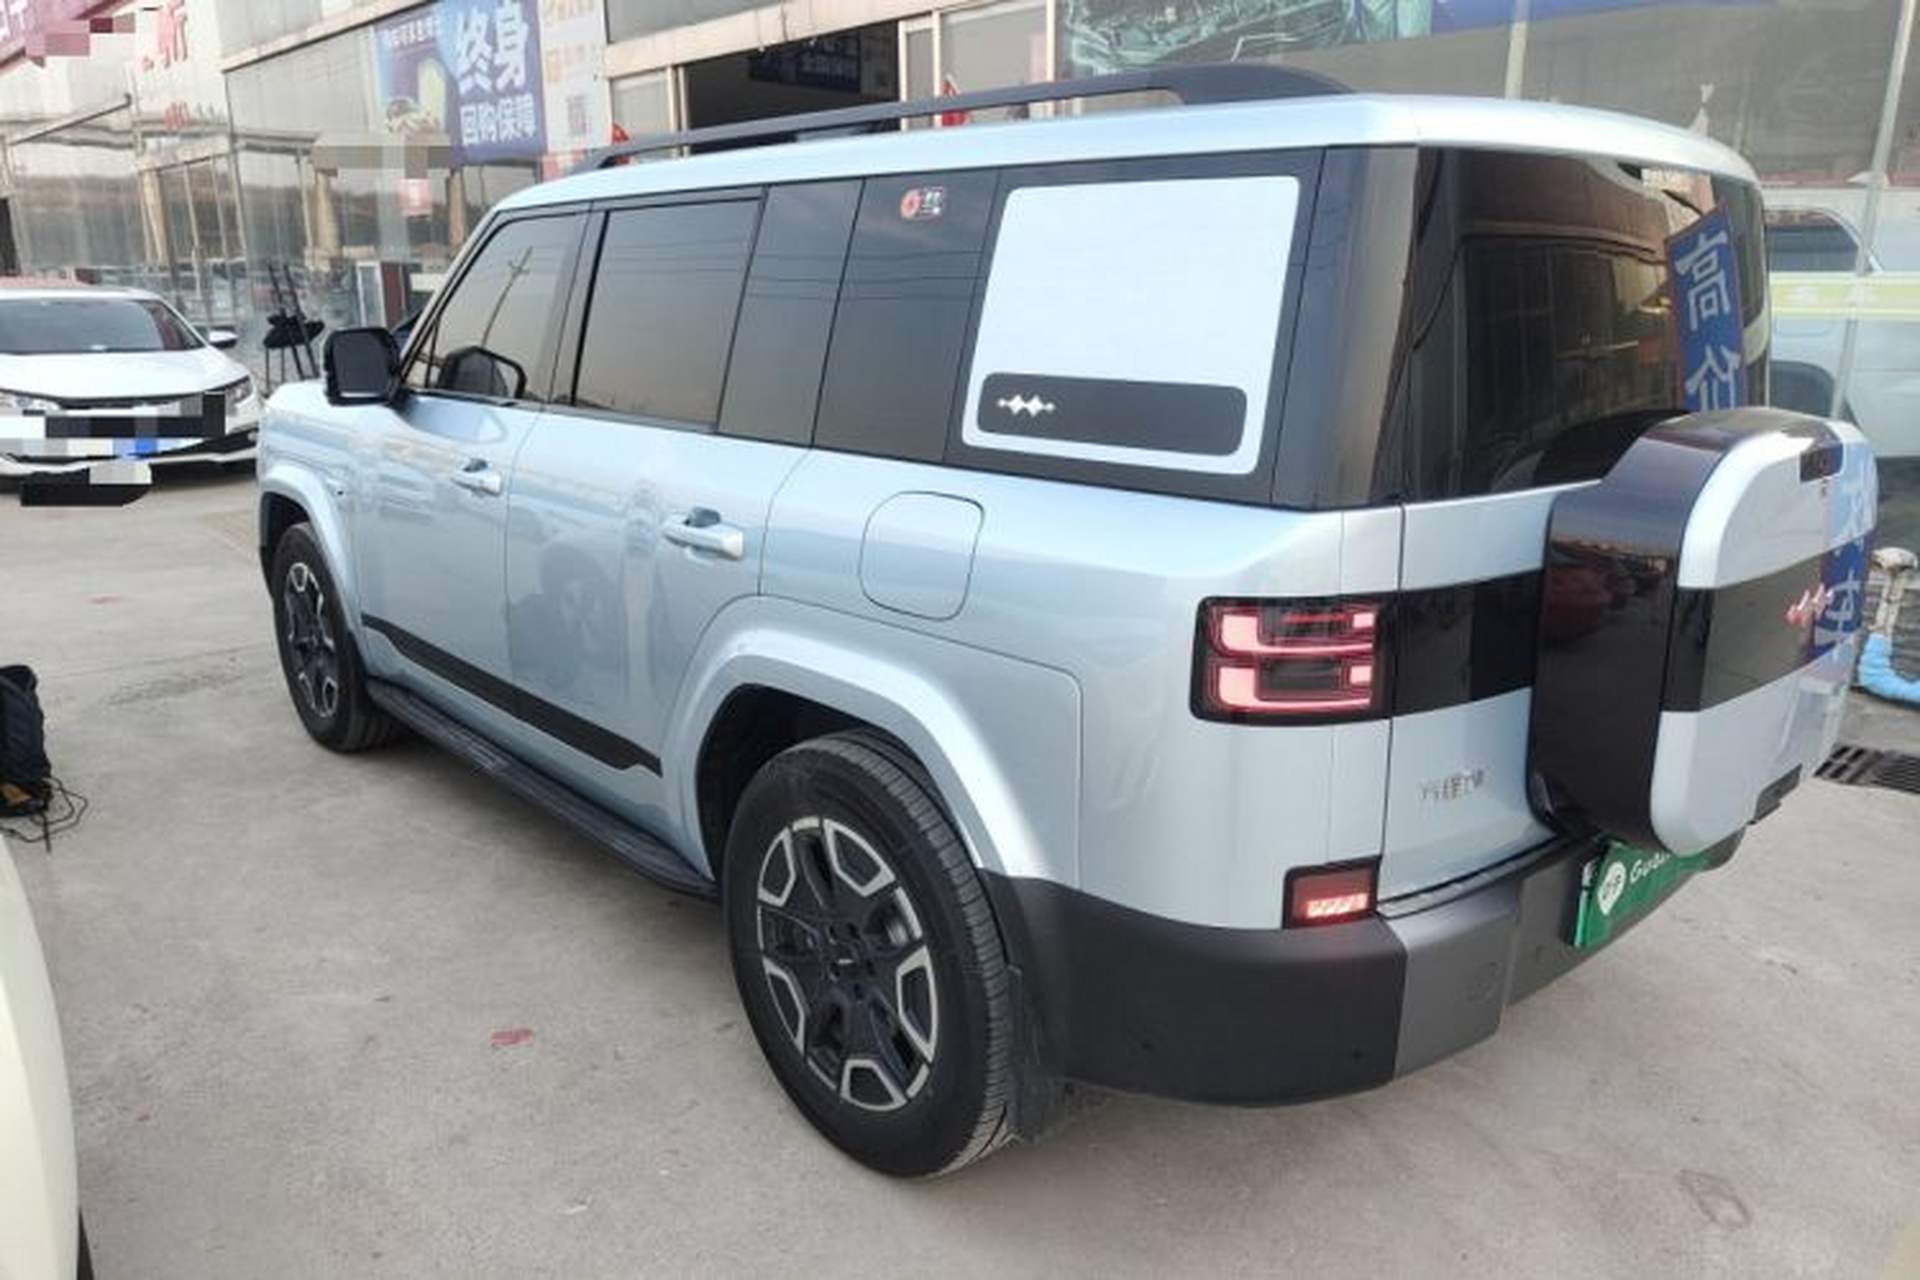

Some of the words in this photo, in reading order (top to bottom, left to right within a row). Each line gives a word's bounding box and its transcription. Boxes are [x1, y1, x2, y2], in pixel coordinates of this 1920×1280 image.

[456, 1, 529, 95] 终身
[459, 92, 536, 147] 回购保障
